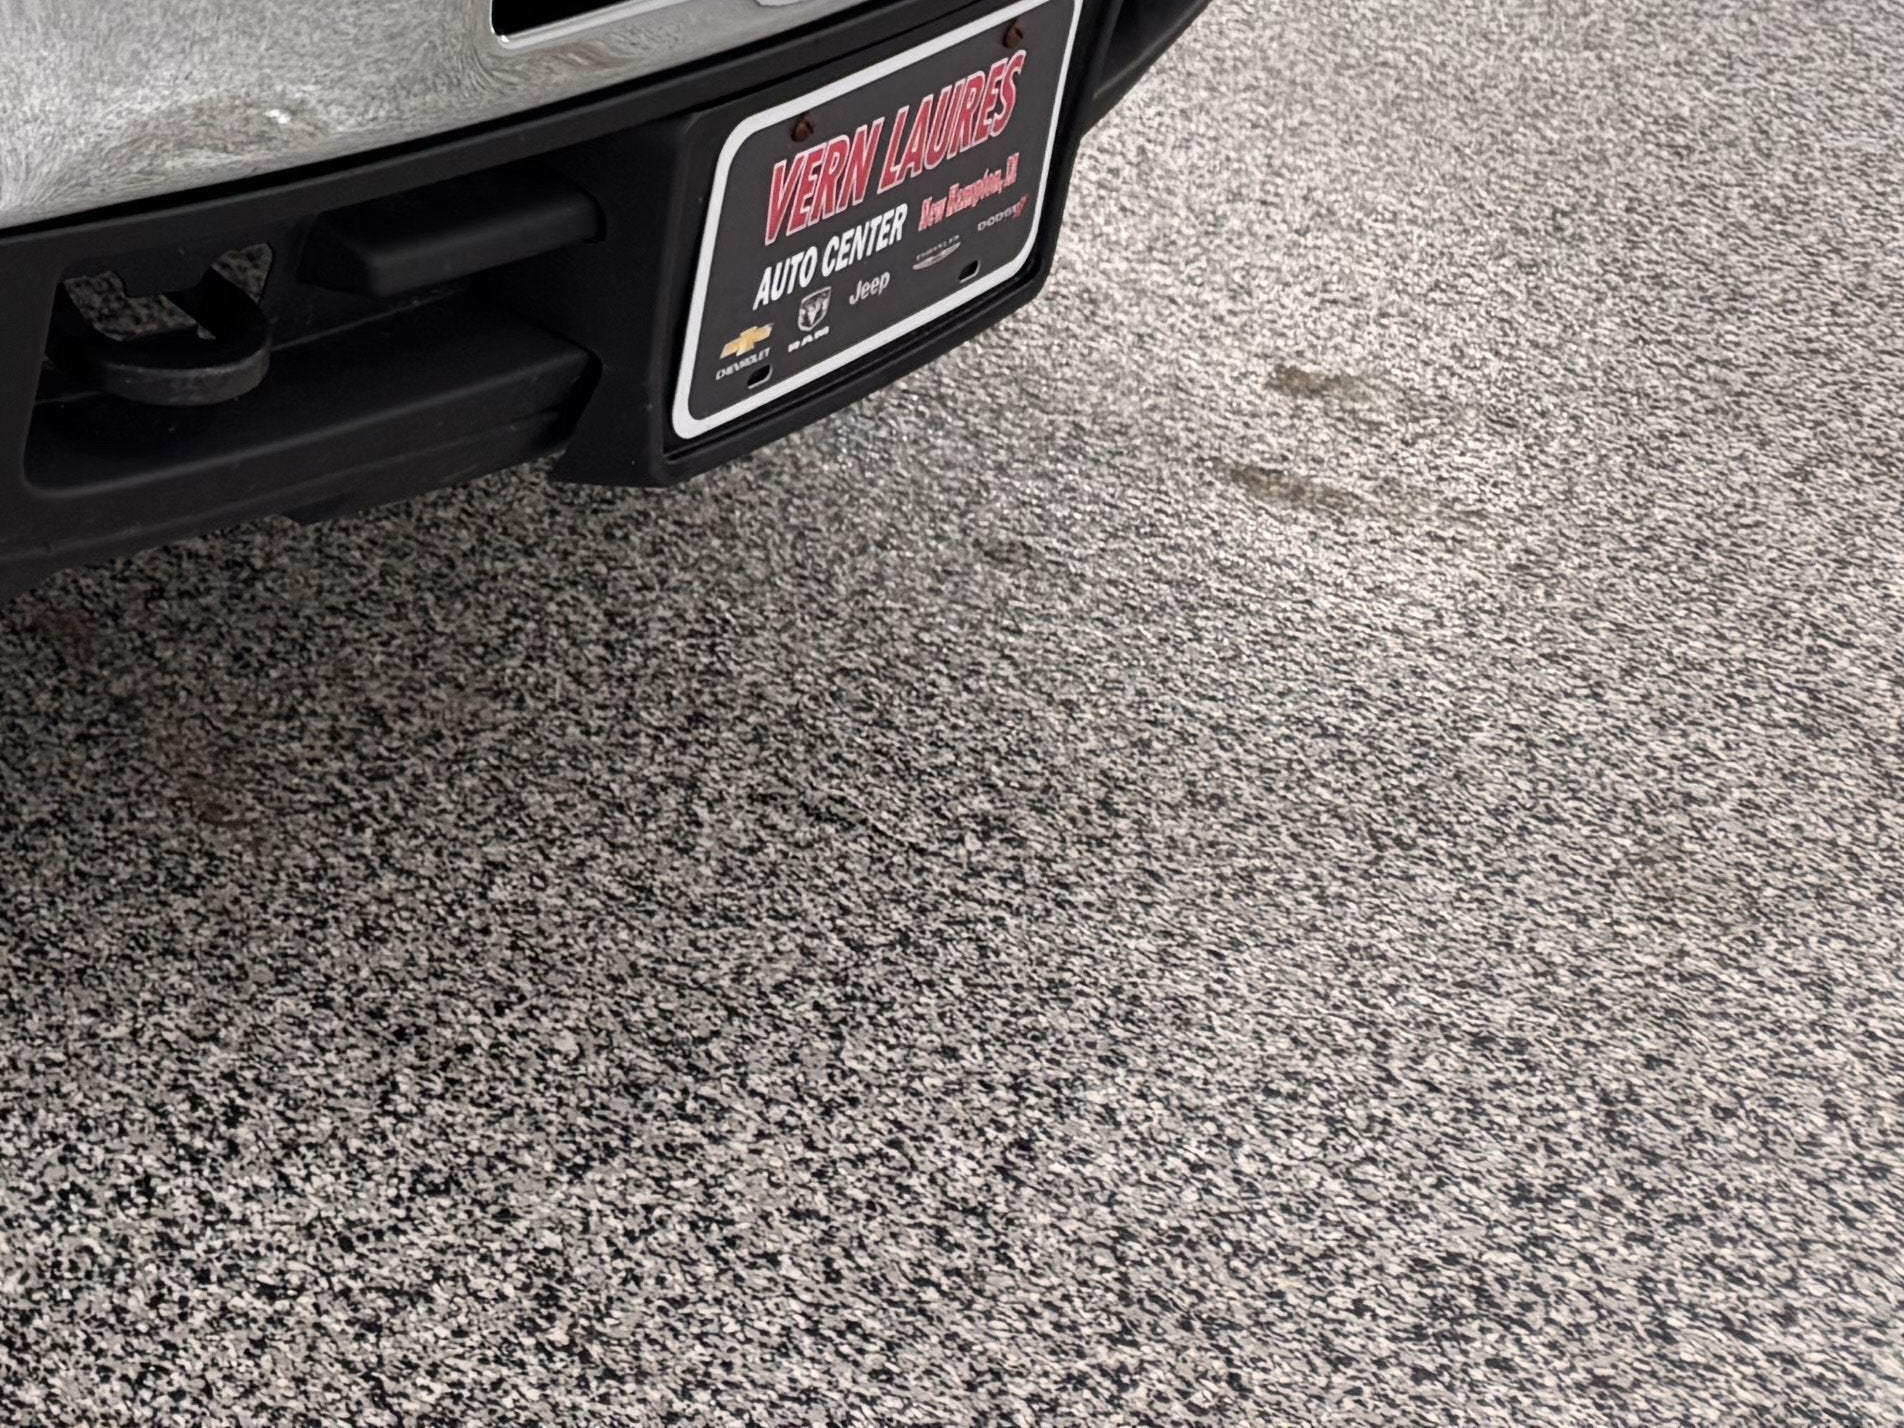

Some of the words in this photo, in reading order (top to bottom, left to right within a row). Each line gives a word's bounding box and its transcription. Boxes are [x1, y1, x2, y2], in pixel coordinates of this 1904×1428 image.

[764, 115, 885, 246] VERN
[876, 48, 1027, 190] LAURES
[752, 246, 818, 311] AUTO
[821, 202, 909, 278] CENTER
[849, 271, 891, 305] Jeep
[715, 347, 771, 380] CHEVROLET
